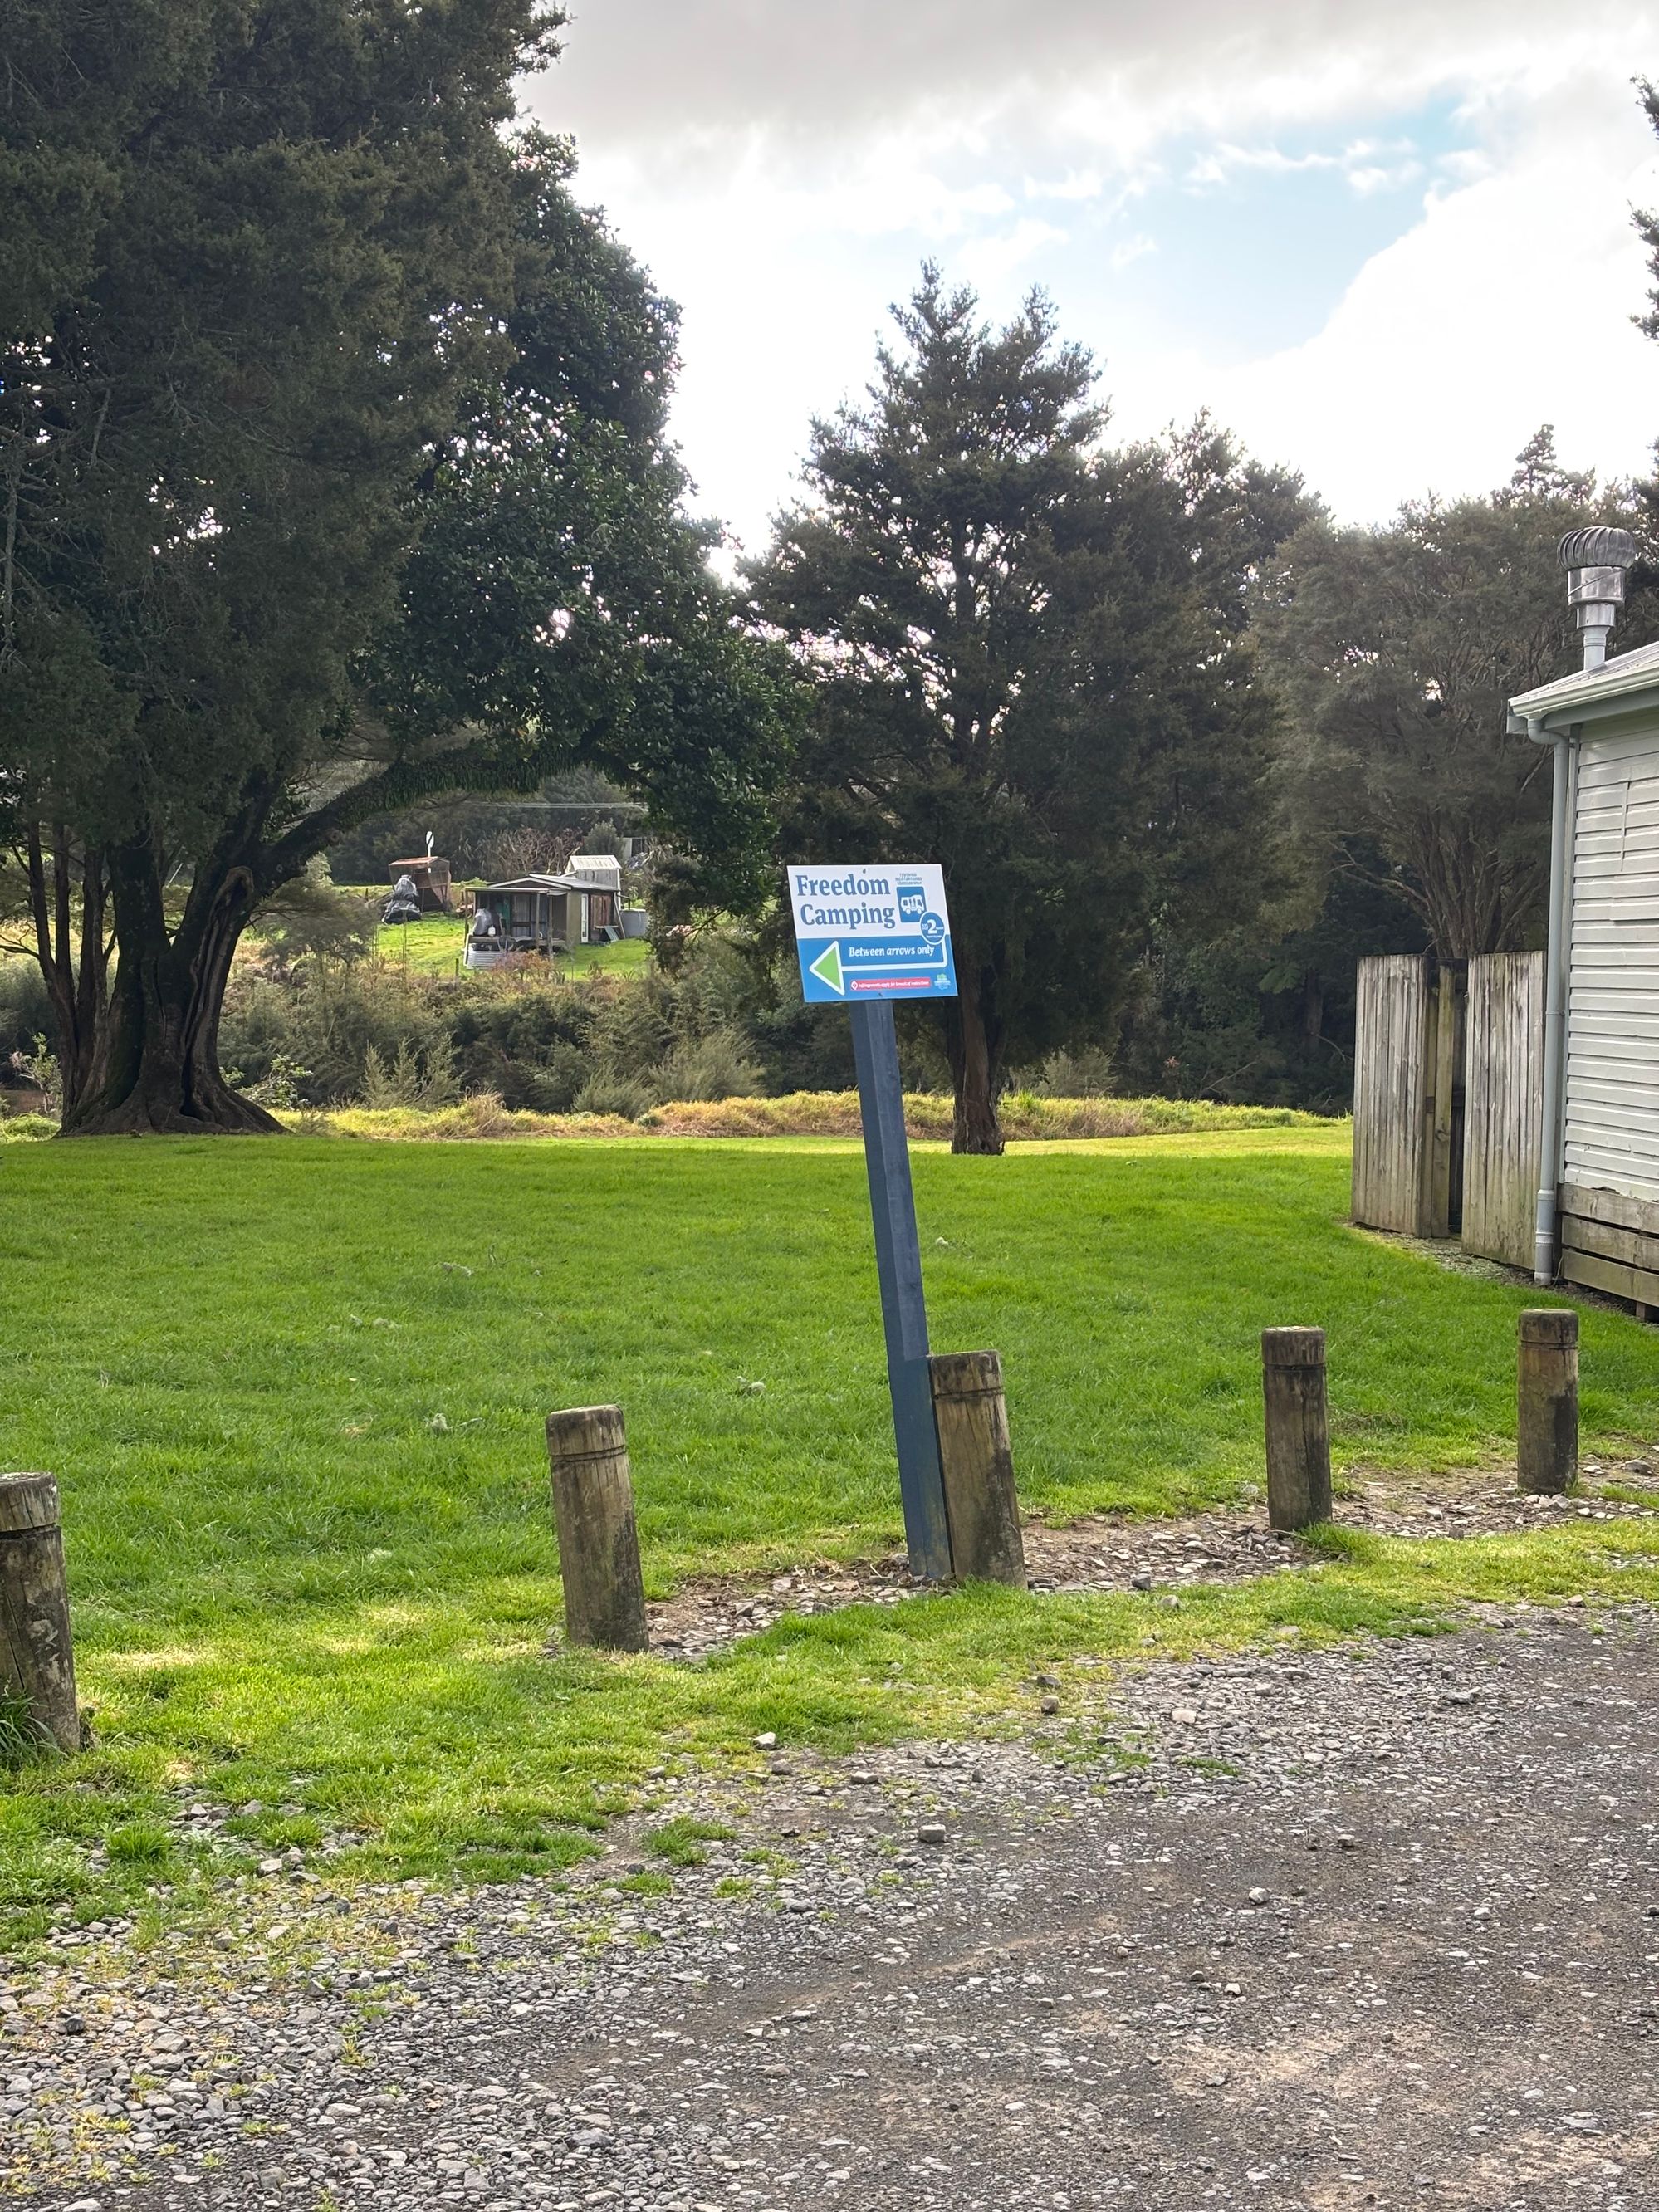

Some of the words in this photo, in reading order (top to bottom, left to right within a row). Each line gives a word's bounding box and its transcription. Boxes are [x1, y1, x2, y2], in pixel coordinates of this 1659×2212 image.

[795, 874, 890, 896] Freedom
[800, 903, 895, 929] Camping
[927, 919, 937, 934] 2
[849, 947, 884, 957] Between
[886, 947, 915, 956] arrows
[917, 944, 935, 957] only
